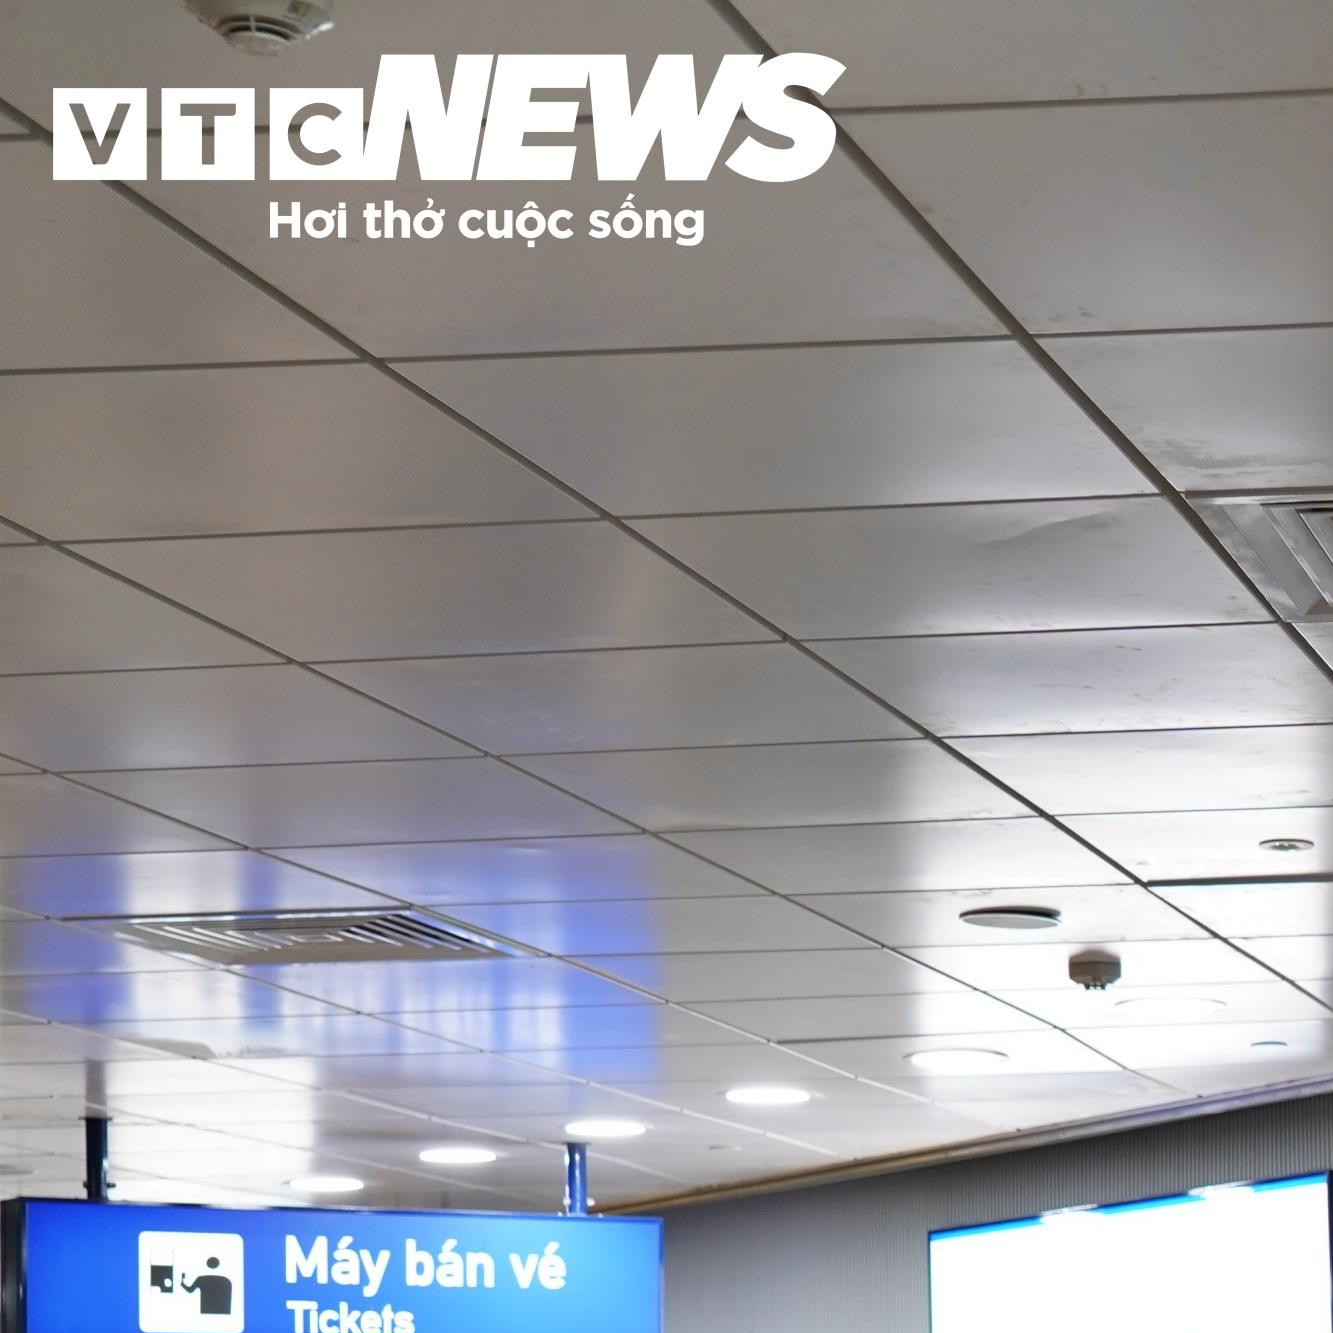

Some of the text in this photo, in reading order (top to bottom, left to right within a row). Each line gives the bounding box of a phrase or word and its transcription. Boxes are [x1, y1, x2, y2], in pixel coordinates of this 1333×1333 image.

[285, 1234, 567, 1298] Máy bán vé
